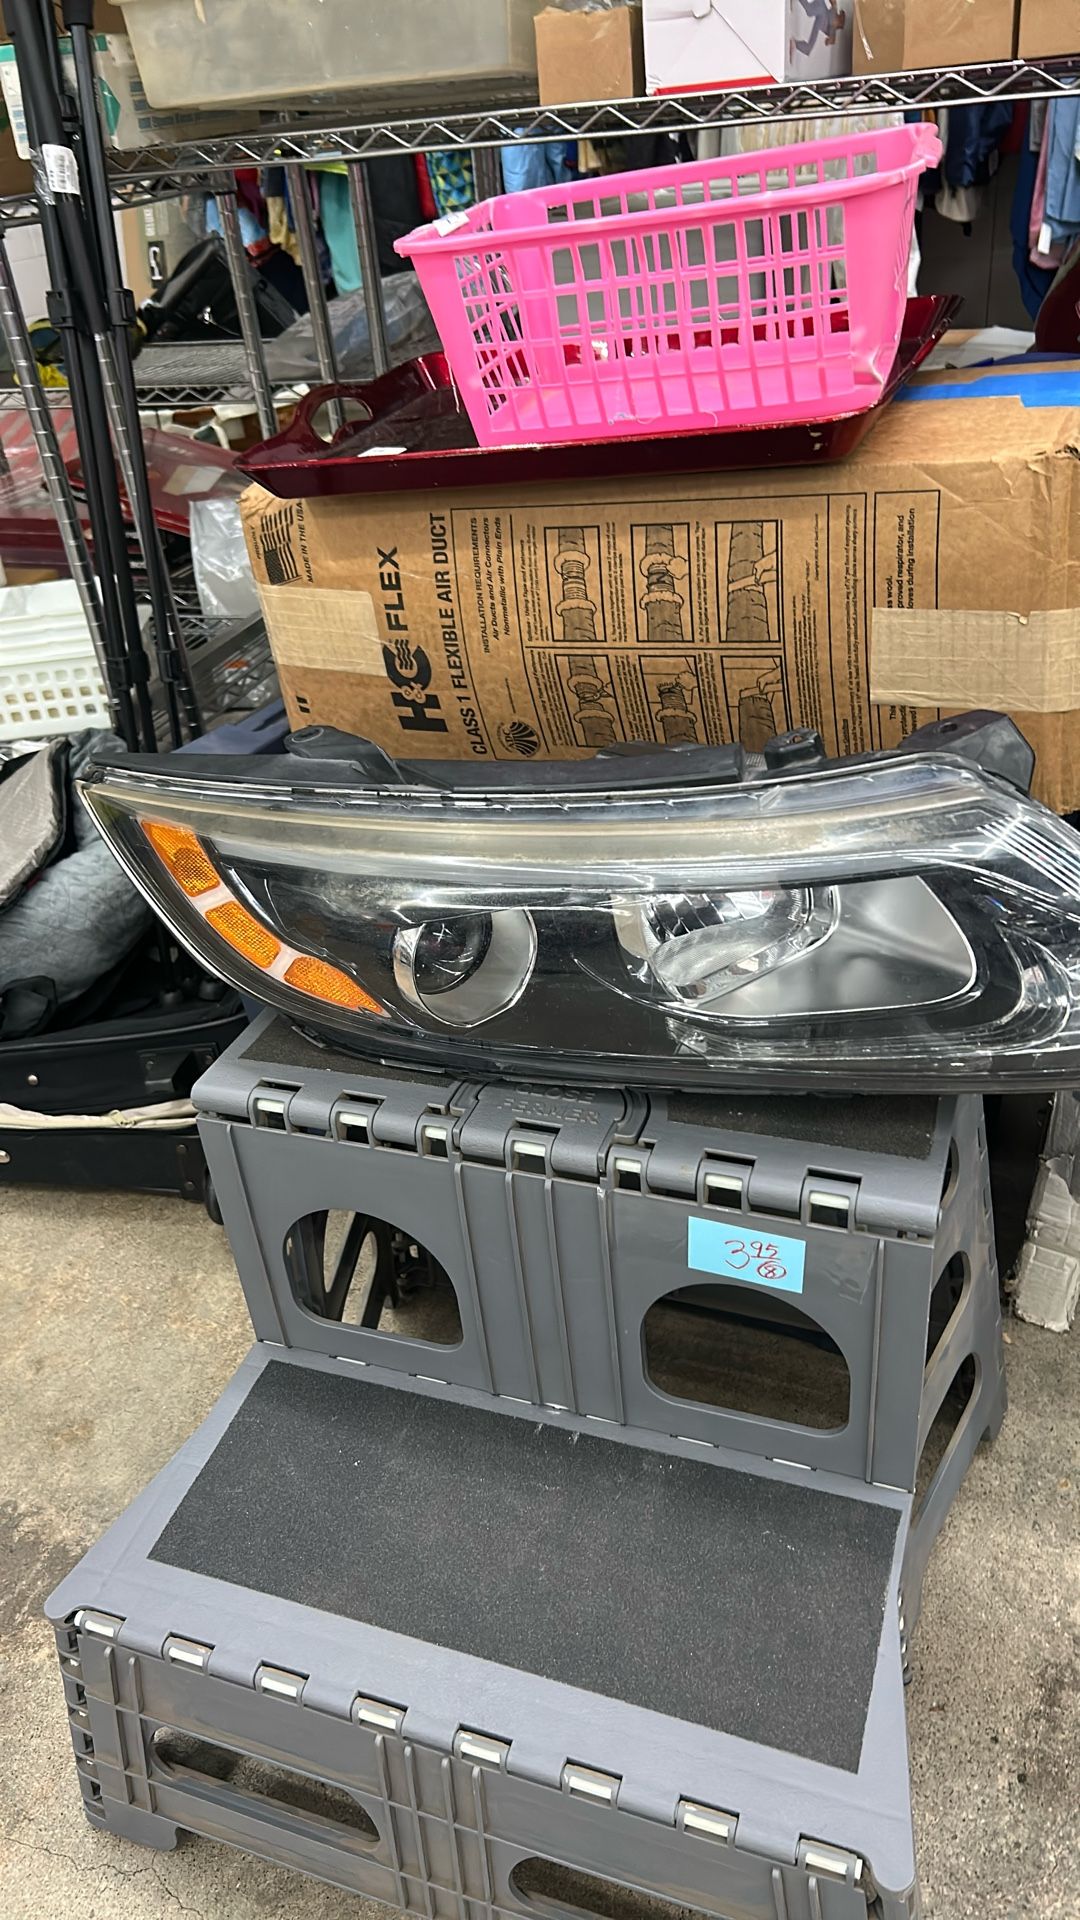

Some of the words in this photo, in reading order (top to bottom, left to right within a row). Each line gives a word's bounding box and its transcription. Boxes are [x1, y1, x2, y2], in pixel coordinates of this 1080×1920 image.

[250, 525, 262, 560] PROUDLY
[297, 524, 306, 542] THE
[429, 512, 449, 564] DUCT
[483, 517, 491, 568] Connectors
[494, 517, 502, 540] Ends
[906, 508, 915, 557] installation
[300, 544, 308, 555] IN
[470, 517, 483, 591] REQUIREMENTS
[495, 541, 503, 563] Plain
[896, 533, 905, 578] respirator,
[302, 556, 314, 584] MADE
[434, 571, 453, 603] AIR
[497, 565, 505, 584] with
[885, 575, 893, 598] wool.
[906, 558, 915, 586] during
[376, 546, 408, 631] FLEX
[477, 592, 490, 654] INSTALLATION
[500, 586, 510, 636] Nonmetallic
[439, 608, 468, 689] FLEXIBLE
[460, 708, 487, 755] CLASS
[515, 1083, 596, 1105] CLOSE
